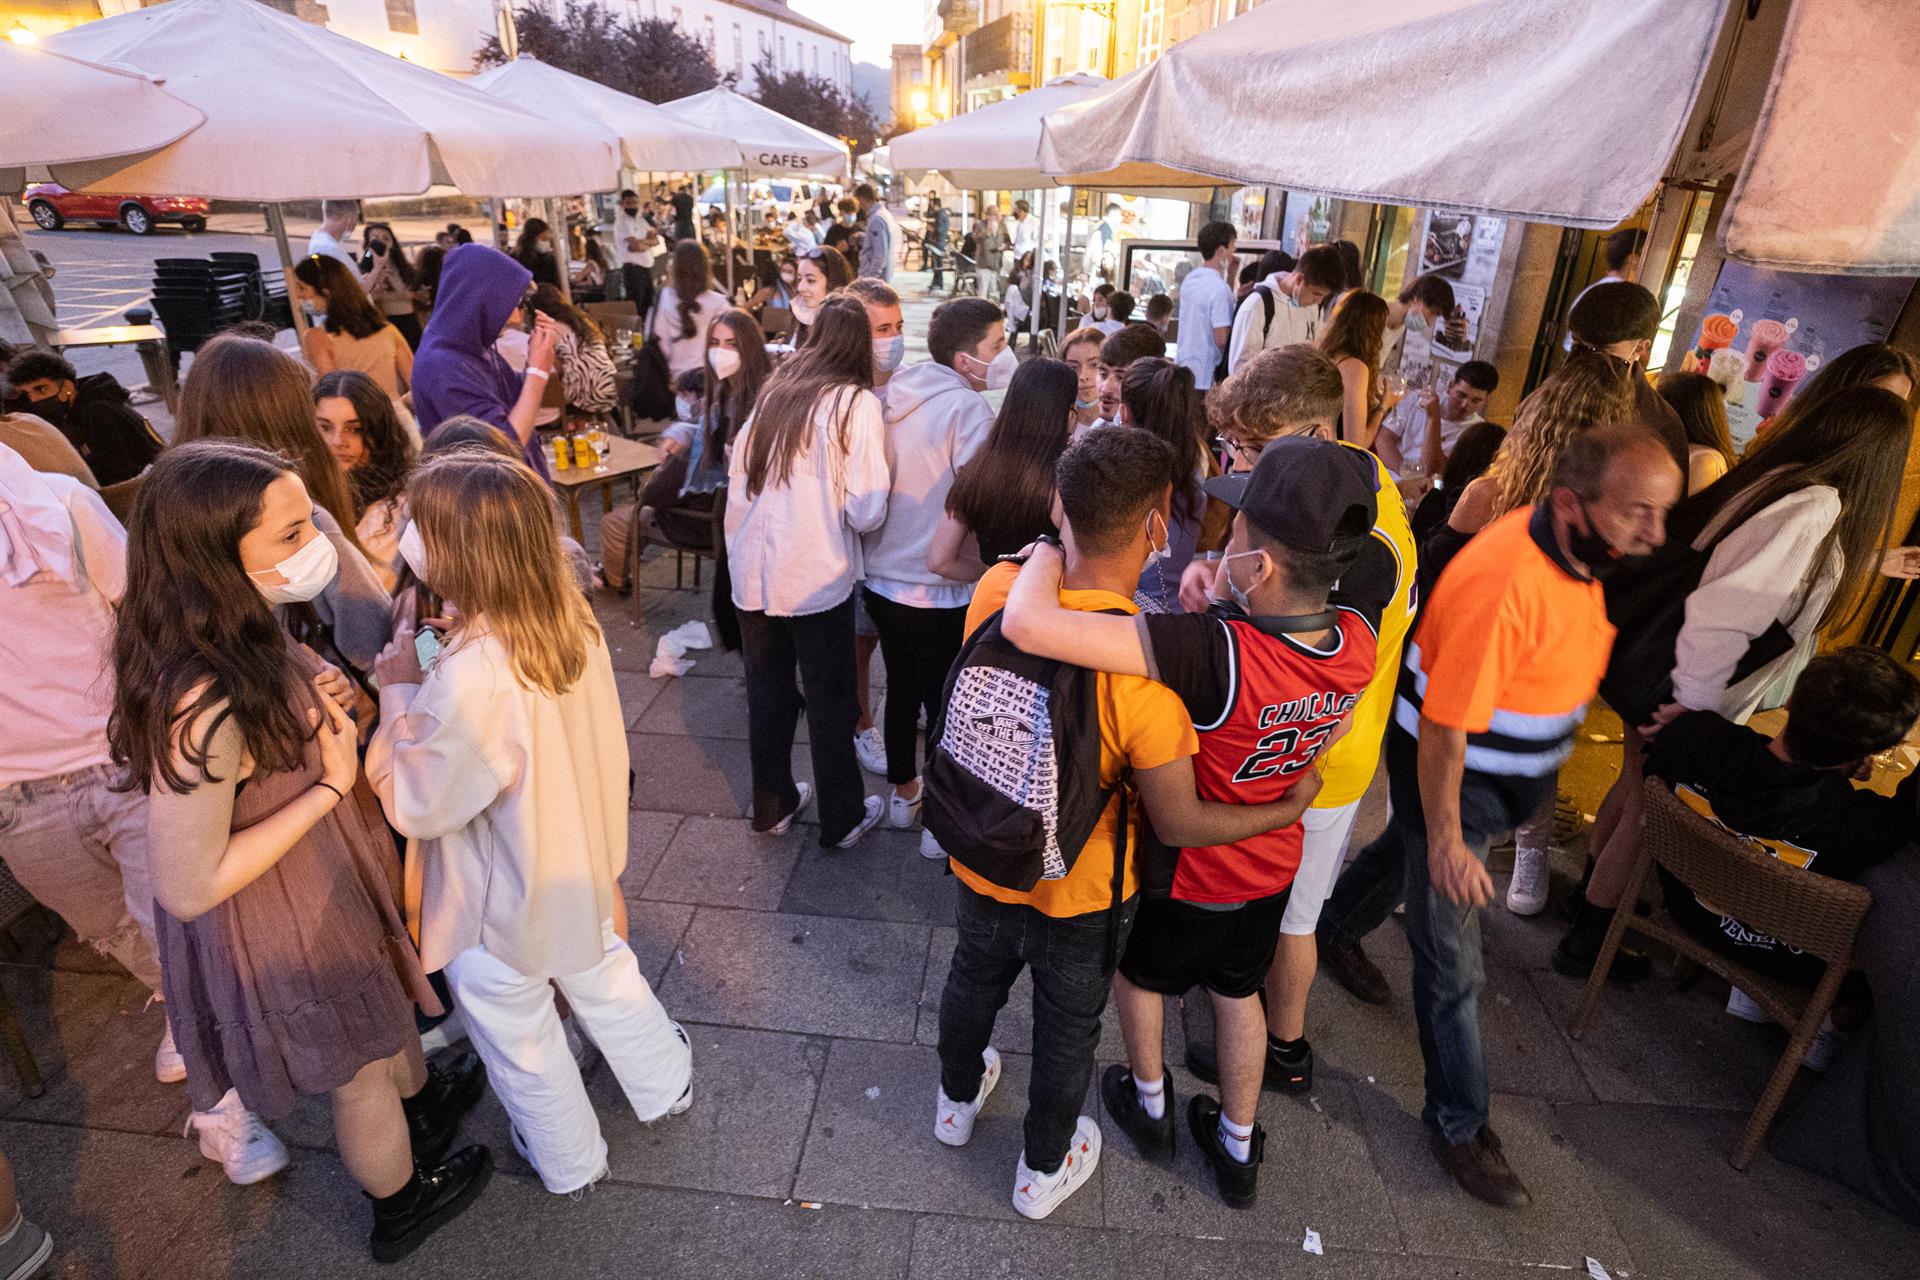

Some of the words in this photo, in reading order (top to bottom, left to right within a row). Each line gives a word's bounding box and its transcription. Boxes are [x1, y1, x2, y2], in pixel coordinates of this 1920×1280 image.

[759, 152, 808, 168] CAFÉS
[992, 715, 1019, 730] VANS
[993, 726, 1013, 741] THE
[1232, 719, 1341, 783] 23
